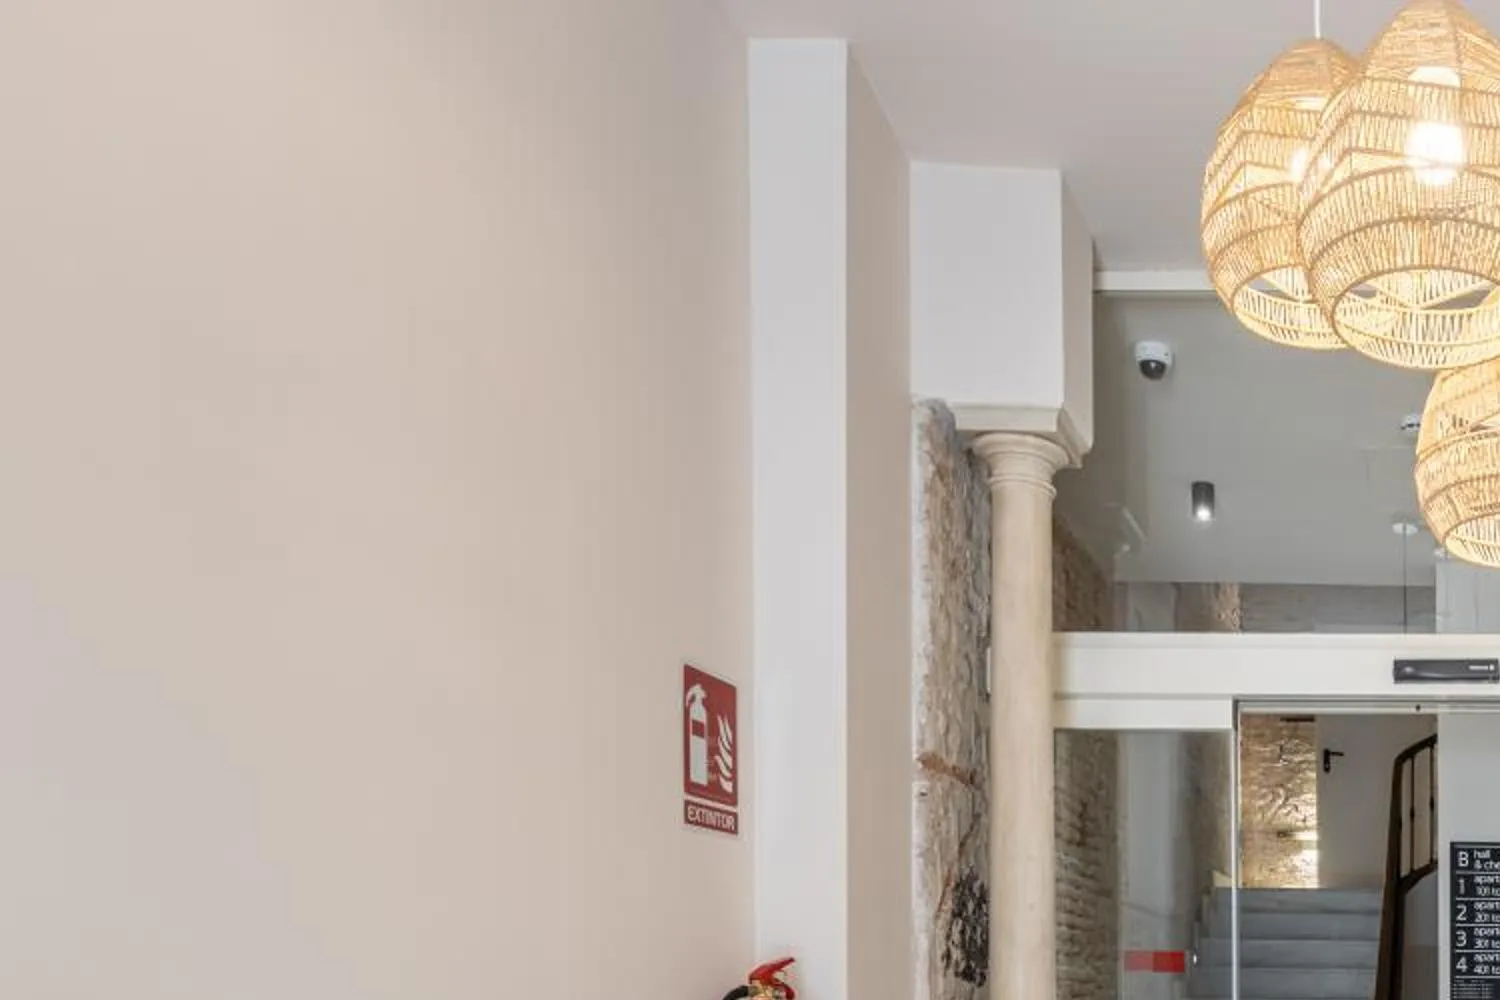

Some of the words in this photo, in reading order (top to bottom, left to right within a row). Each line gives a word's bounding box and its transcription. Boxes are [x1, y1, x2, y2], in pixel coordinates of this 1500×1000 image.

[687, 804, 735, 830] EXTINTOR
[1458, 851, 1469, 867] B
[1474, 849, 1491, 859] hall
[1459, 878, 1465, 895] 1
[1476, 885, 1491, 896] 101
[1456, 904, 1467, 921] 2
[1474, 912, 1490, 922] 201
[1456, 930, 1467, 947] 3
[1474, 938, 1490, 949] 301
[1456, 956, 1468, 973] 4
[1474, 964, 1490, 974] 401
